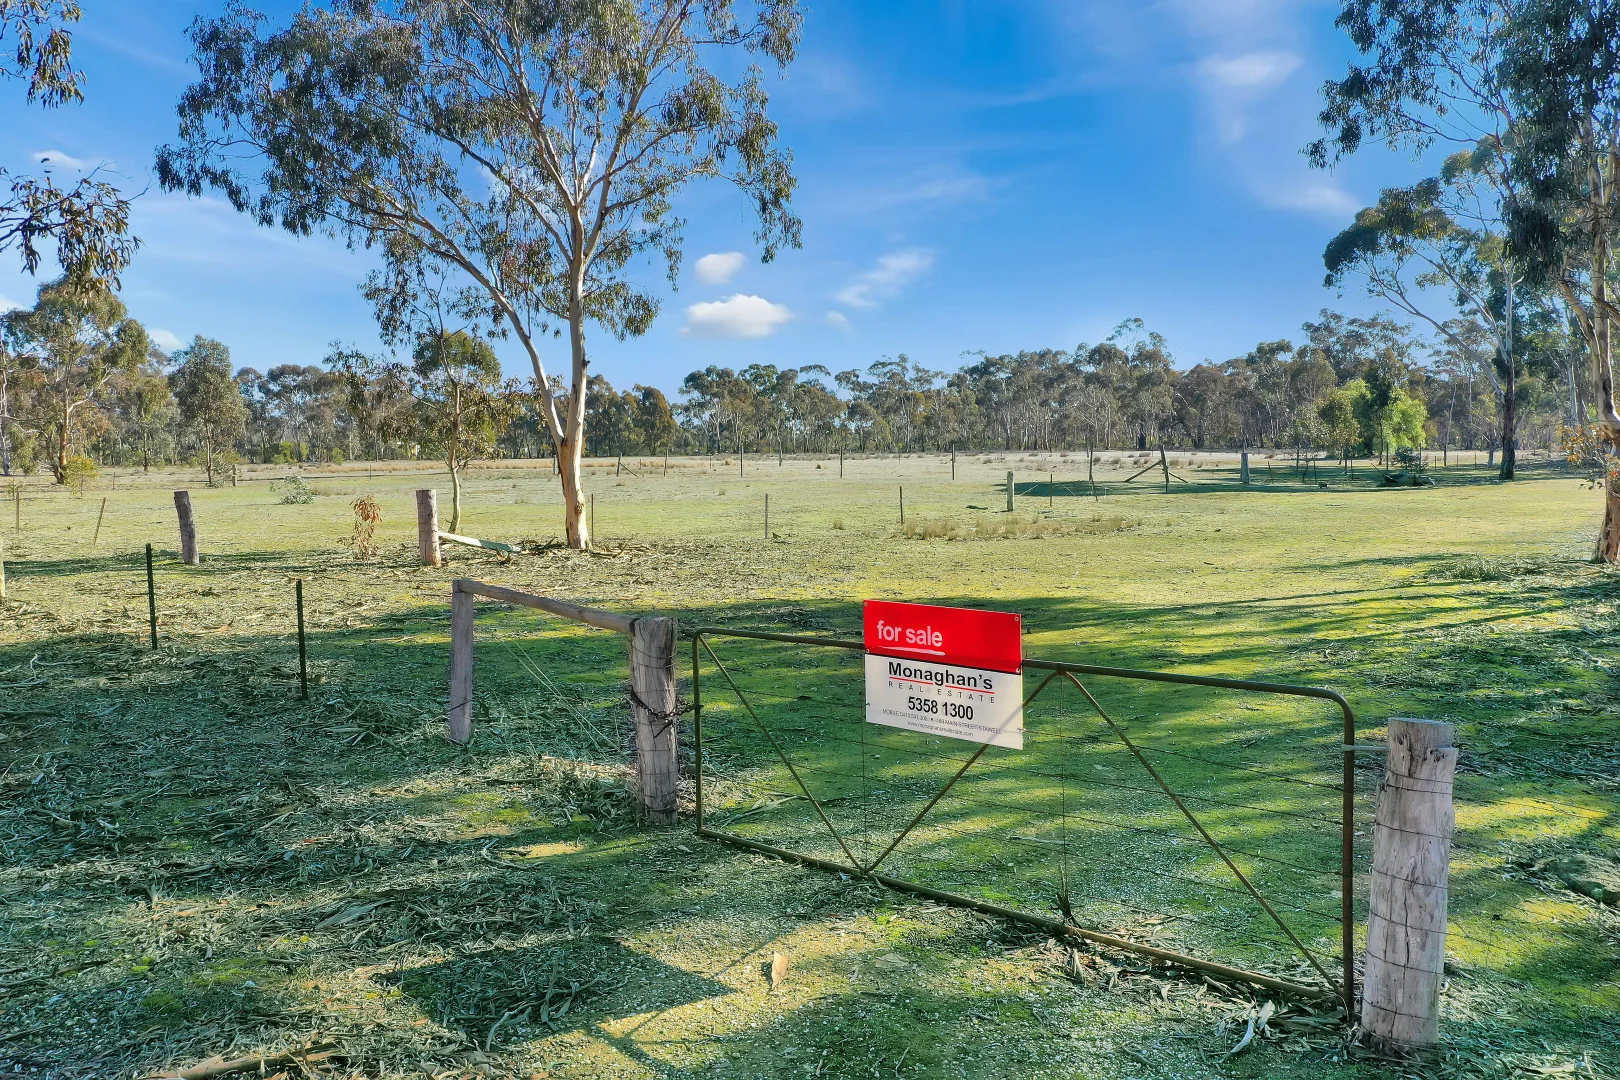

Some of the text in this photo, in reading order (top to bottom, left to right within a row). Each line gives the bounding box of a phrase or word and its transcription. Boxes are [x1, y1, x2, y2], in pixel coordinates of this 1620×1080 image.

[876, 620, 943, 647] for sale
[888, 661, 993, 690] Monaghan's
[888, 681, 995, 703] REAL ESTATE
[882, 708, 899, 717] MOBILE
[944, 719, 957, 727] MAIN
[957, 721, 977, 730] STREET
[908, 696, 974, 720] 5358 1300
